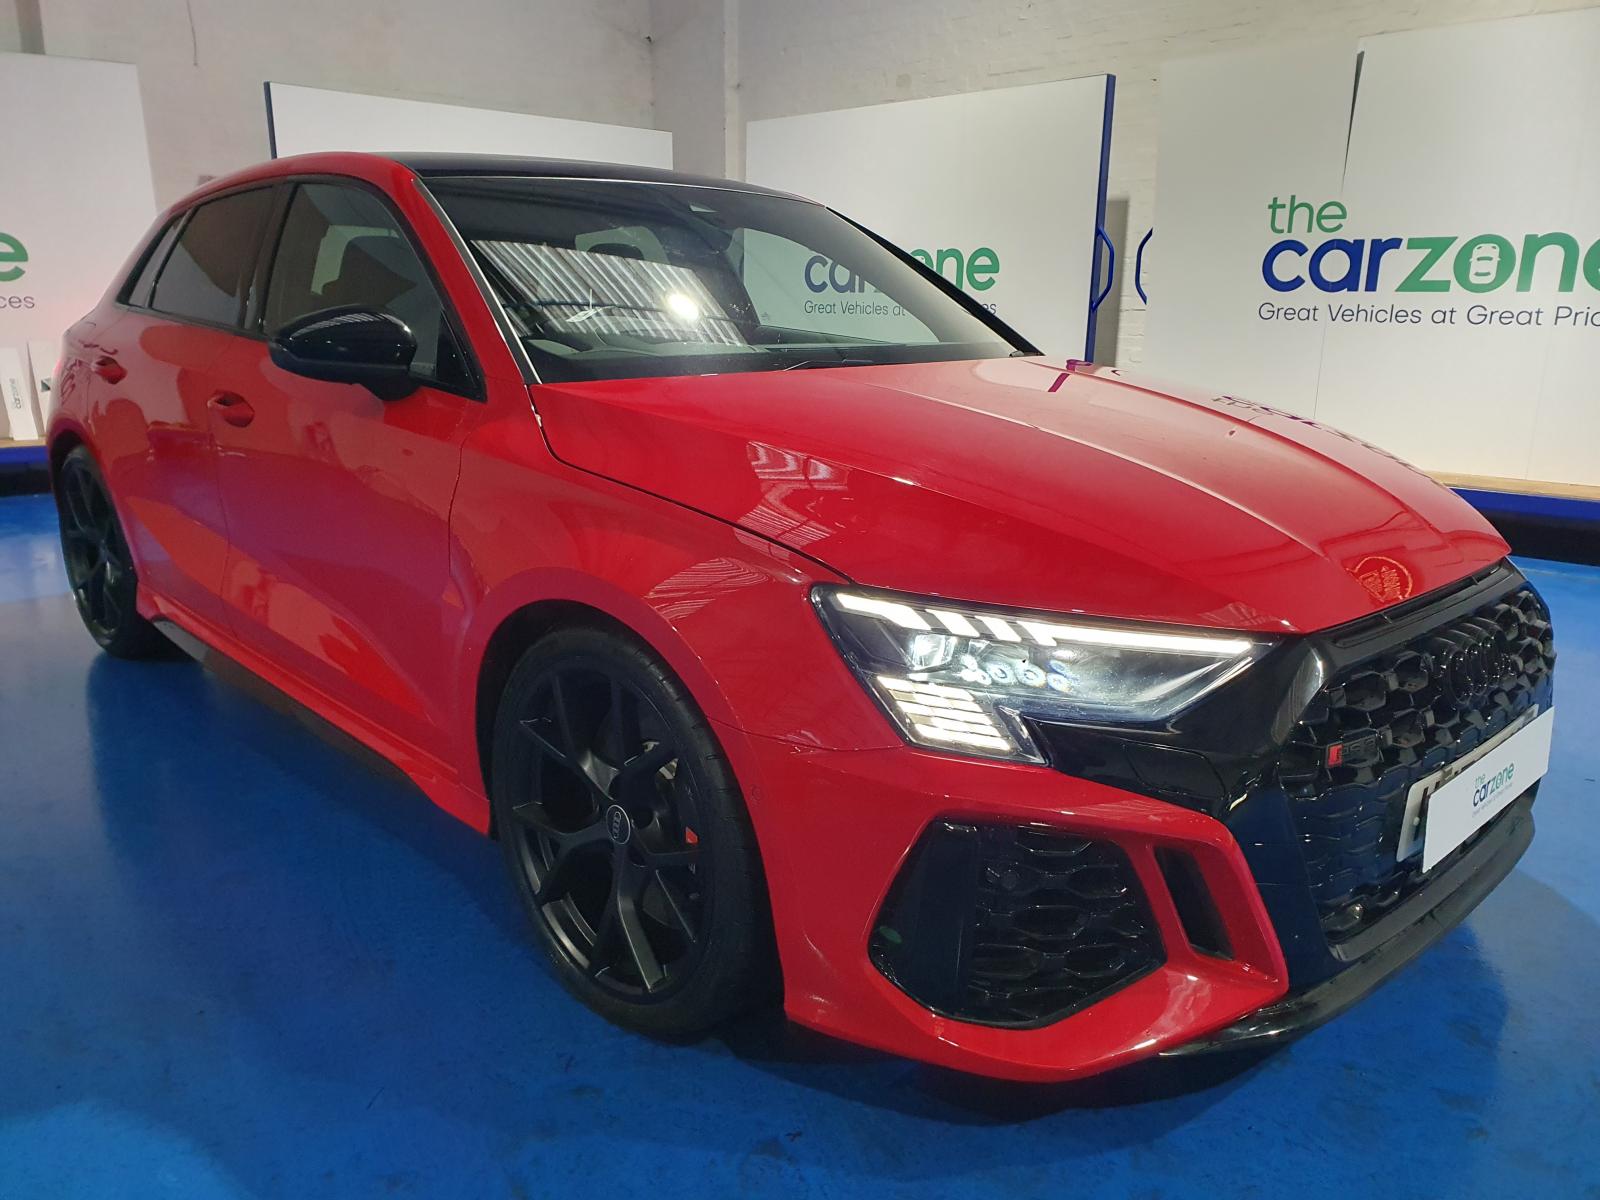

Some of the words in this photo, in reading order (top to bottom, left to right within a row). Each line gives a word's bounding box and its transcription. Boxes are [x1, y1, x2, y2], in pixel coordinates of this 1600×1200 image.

[1267, 194, 1347, 234] the
[804, 300, 836, 314] Great
[840, 300, 889, 315] Vehicles
[1258, 302, 1319, 321] Great
[1328, 304, 1422, 324] Vehicles
[1431, 307, 1457, 324] at
[1466, 305, 1544, 325] Great
[1473, 762, 1515, 807] carzone
